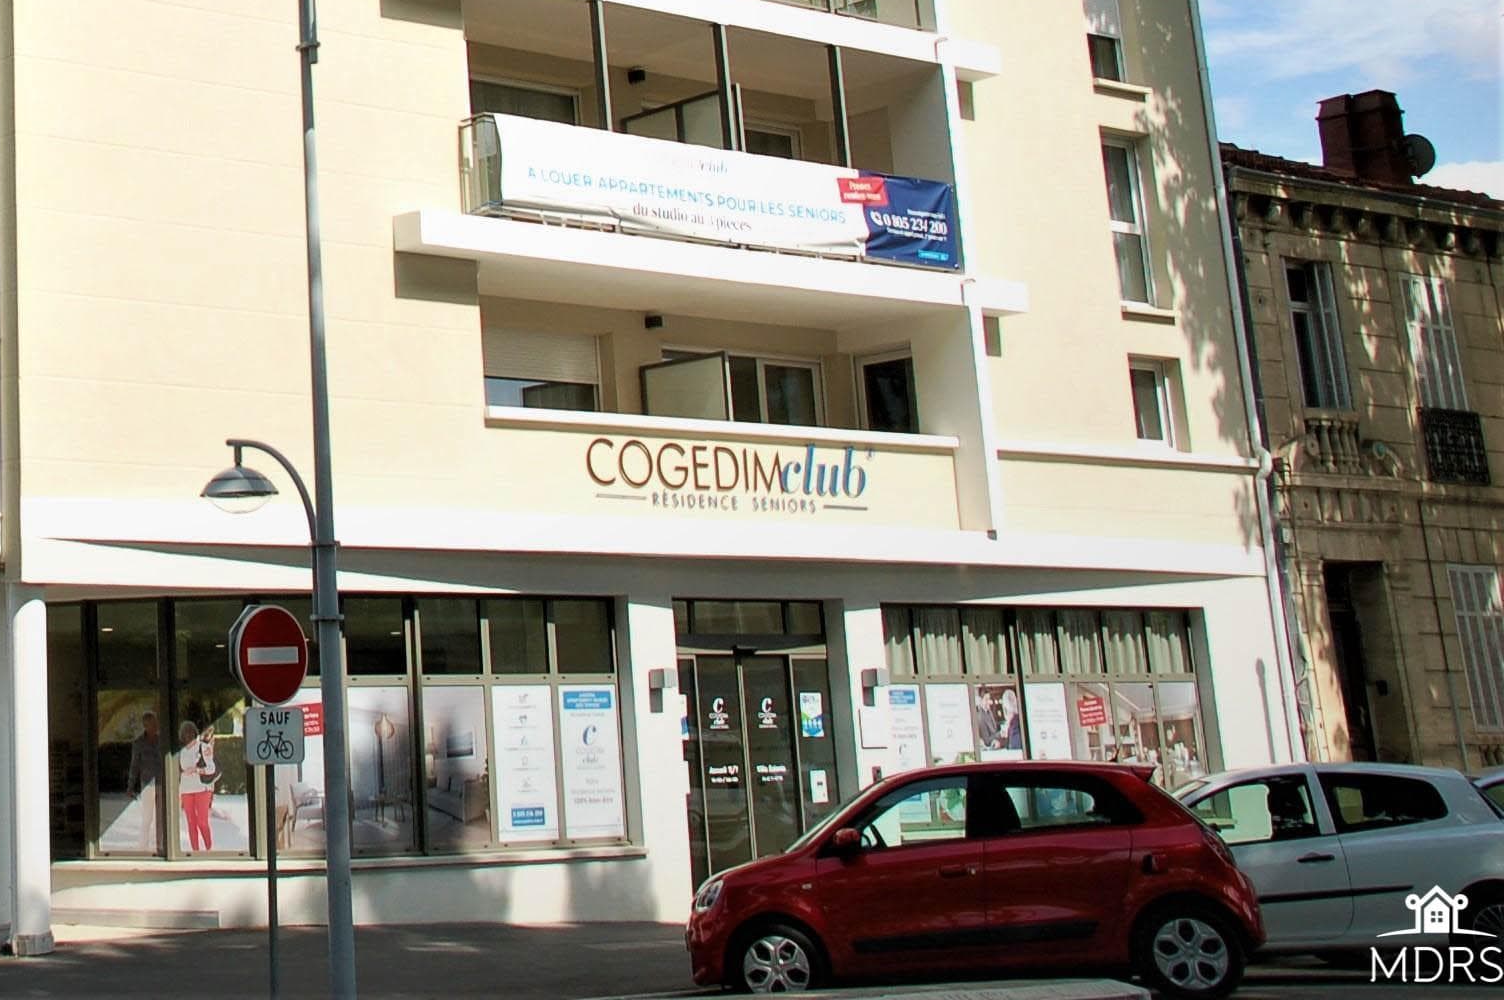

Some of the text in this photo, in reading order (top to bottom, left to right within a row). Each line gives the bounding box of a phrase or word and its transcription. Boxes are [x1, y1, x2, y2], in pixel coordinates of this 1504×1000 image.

[541, 169, 593, 187] LOUER
[599, 177, 714, 207] APPARTEMENTS
[717, 195, 756, 212] POUR
[760, 201, 785, 216] LES
[788, 205, 846, 224] SENIORS
[632, 202, 648, 216] du
[651, 206, 687, 222] studio
[691, 214, 704, 225] au
[883, 213, 892, 226] 0
[909, 217, 929, 233] 234
[929, 220, 948, 235] 200
[260, 711, 291, 725] SAUF
